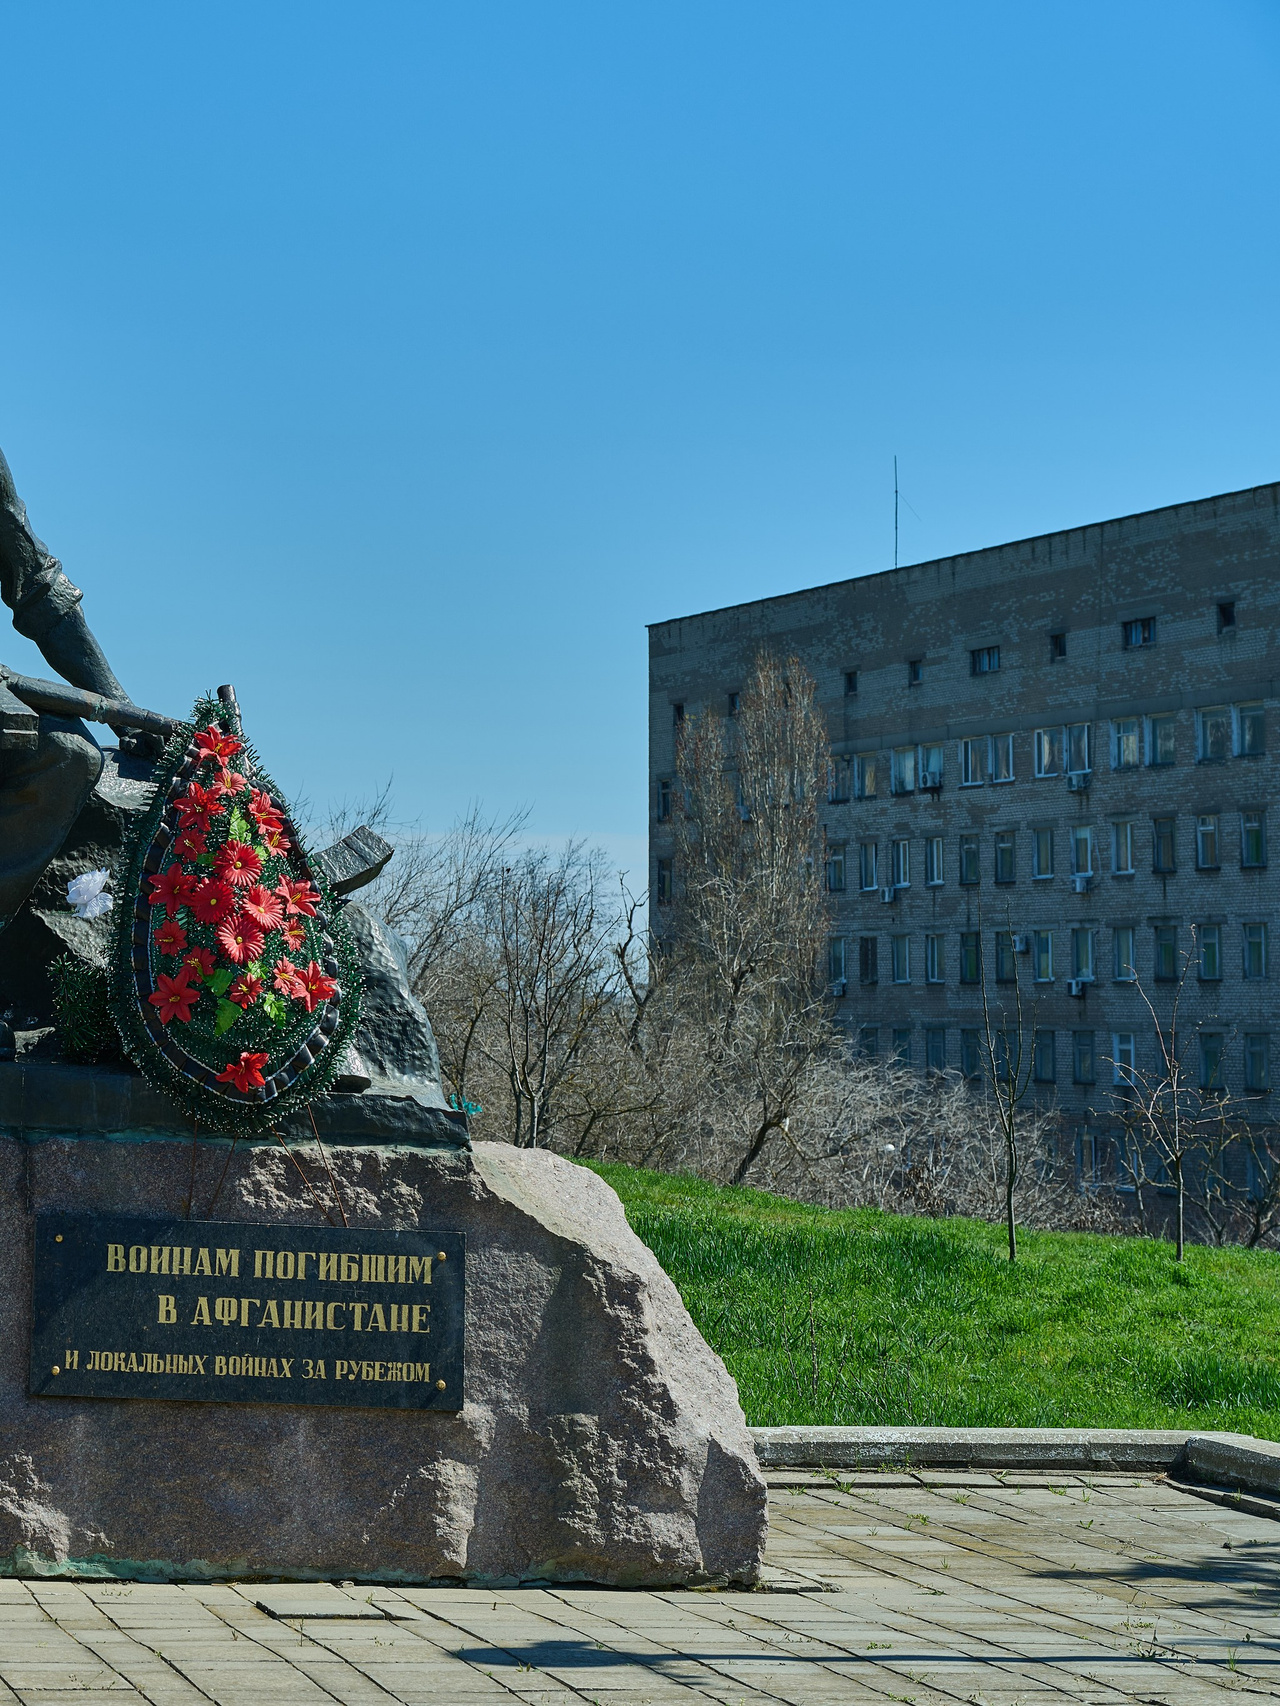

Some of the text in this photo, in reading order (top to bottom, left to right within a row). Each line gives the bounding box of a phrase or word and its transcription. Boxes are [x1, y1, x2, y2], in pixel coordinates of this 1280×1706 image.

[106, 1243, 433, 1285] ВОИНАМ ПОГИБШИМ
[157, 1294, 431, 1334] В АФГАНИСТАНЕ
[64, 1349, 431, 1383] И ЛОКАЛЬНЫХ ВОЙНАХ ЗА РУБЕЖОМ
